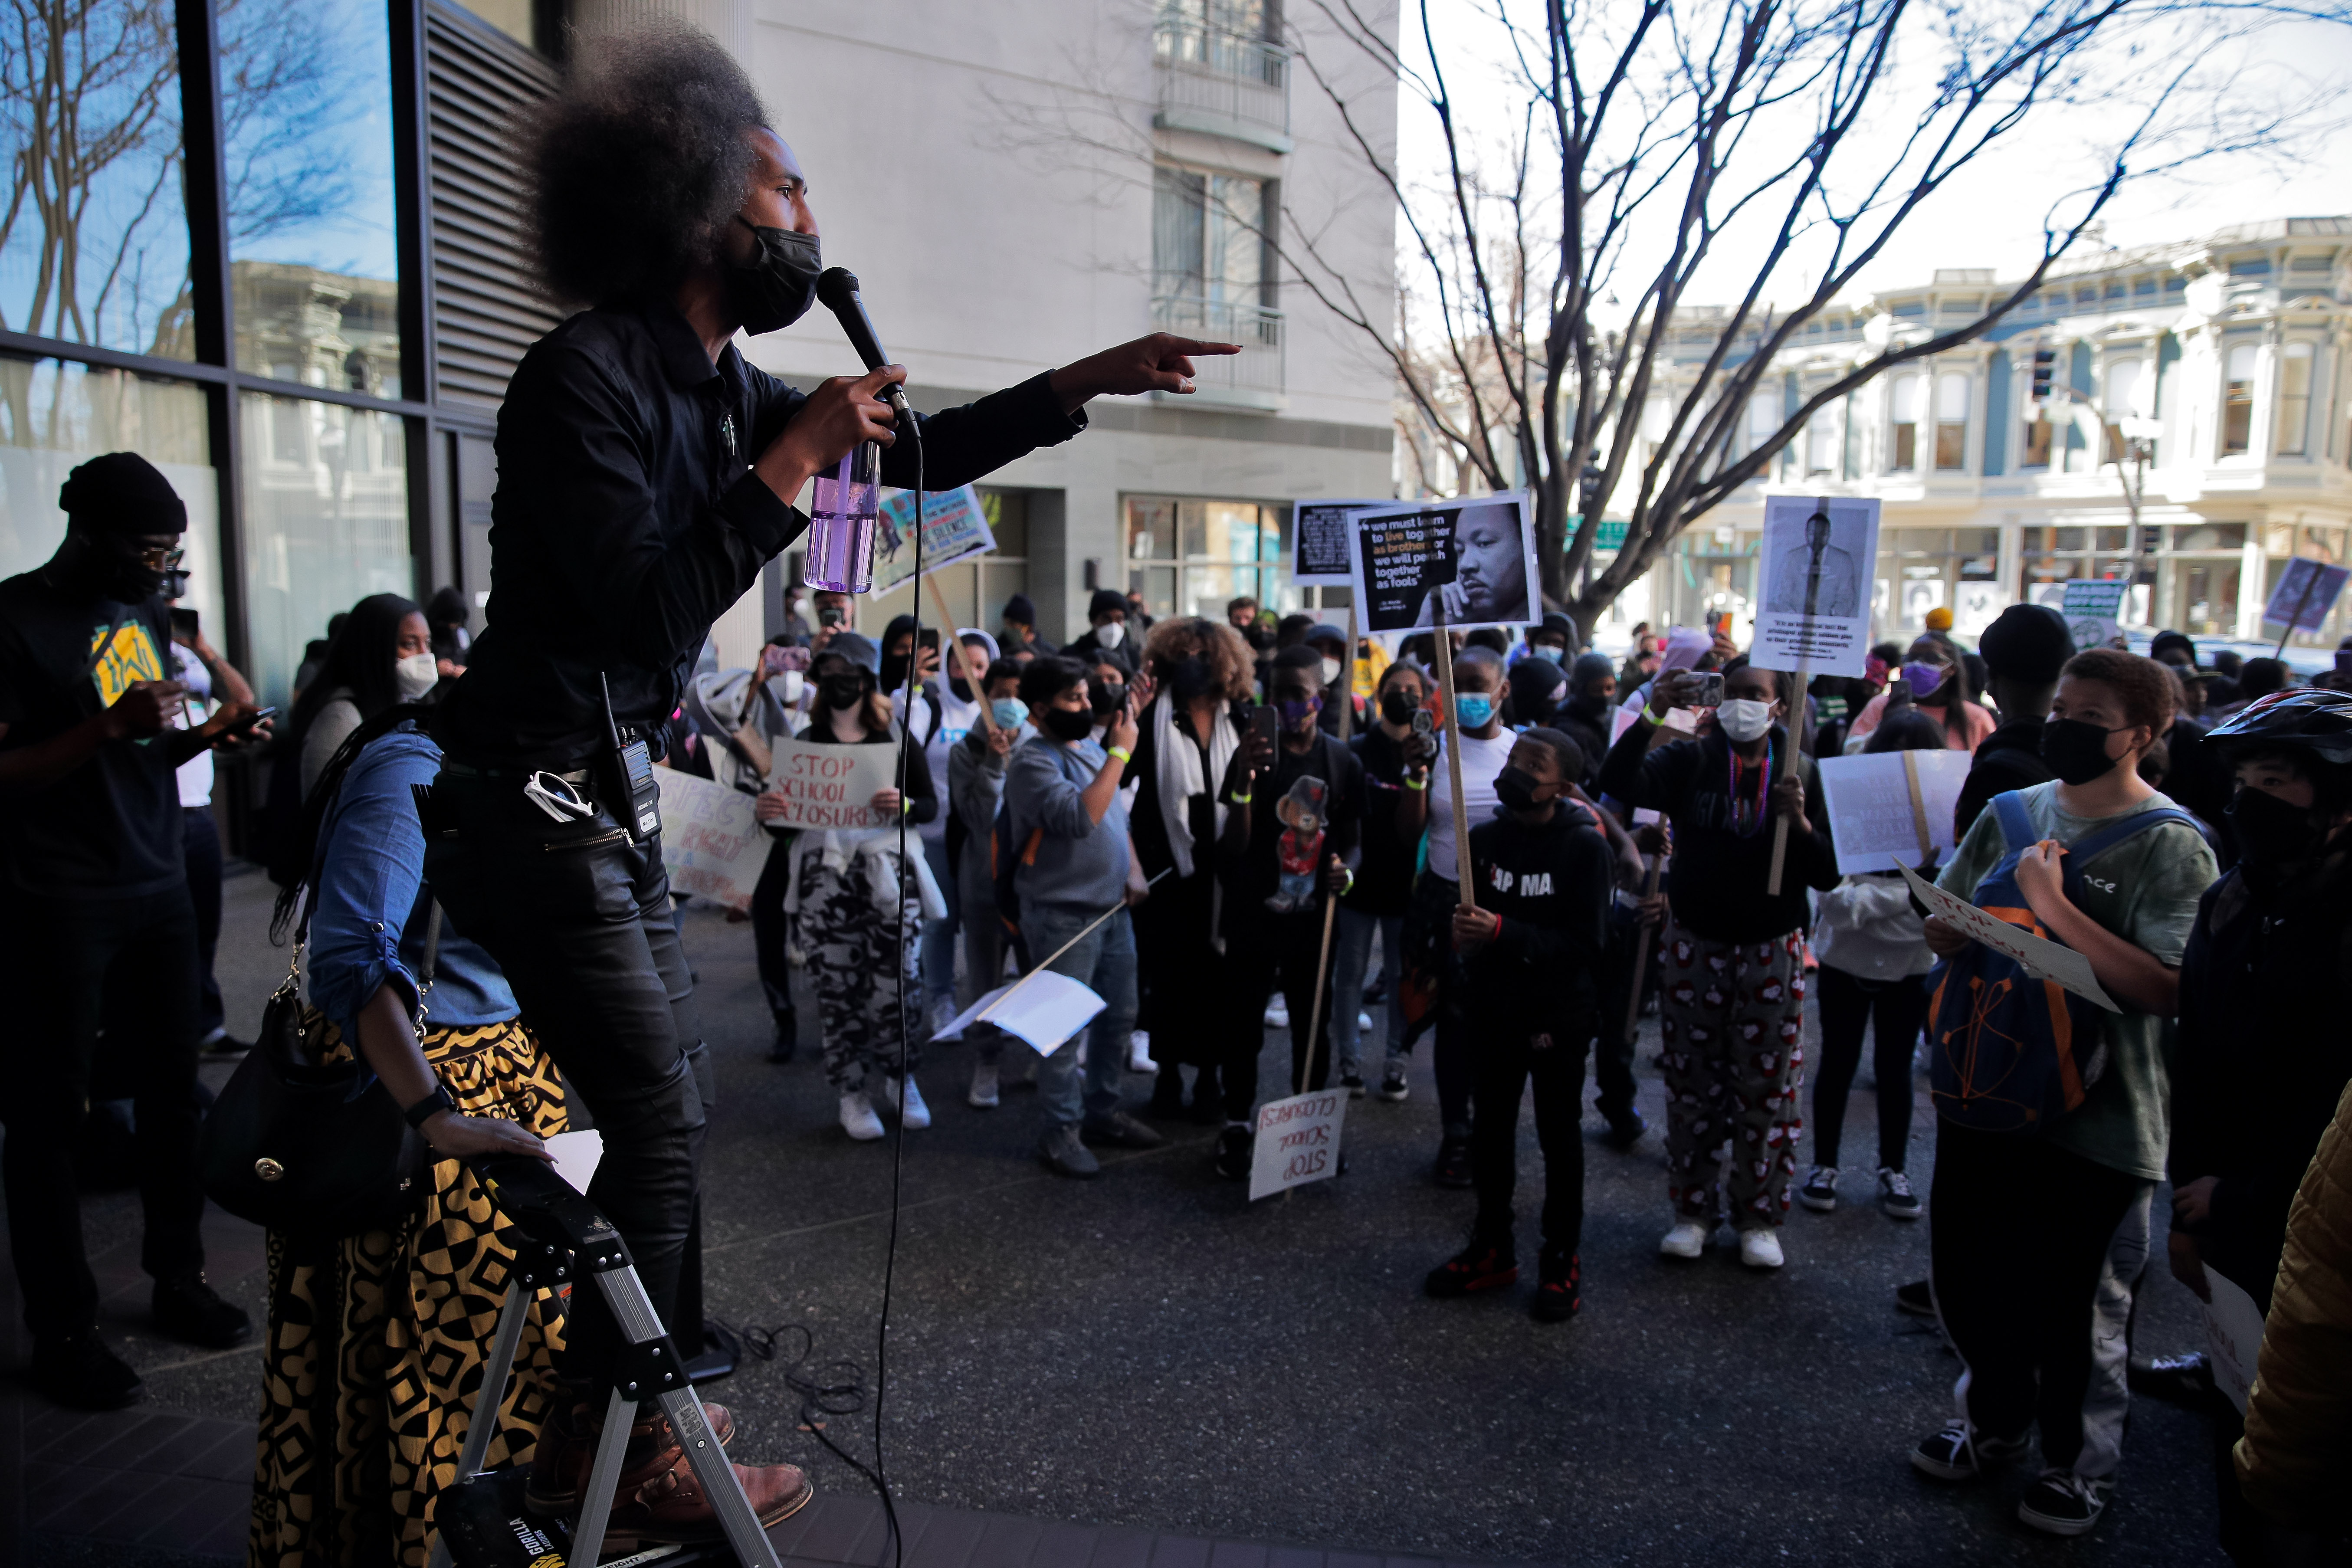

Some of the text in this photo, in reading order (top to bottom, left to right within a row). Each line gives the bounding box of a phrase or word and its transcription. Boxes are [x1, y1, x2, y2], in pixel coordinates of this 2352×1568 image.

[1389, 518, 1416, 530] must
[1372, 533, 1384, 543] to
[1373, 546, 1386, 555] as
[1434, 540, 1445, 549] or
[1374, 557, 1391, 566] we
[1392, 552, 1412, 564] will
[1375, 564, 1421, 579] together
[1376, 581, 1389, 589] as
[789, 753, 855, 778] STOP
[777, 775, 847, 803] SCHOOL
[1283, 1149, 1327, 1181] STOP
[509, 1517, 545, 1555] GORILLA
[534, 1529, 554, 1550] LADDERS
